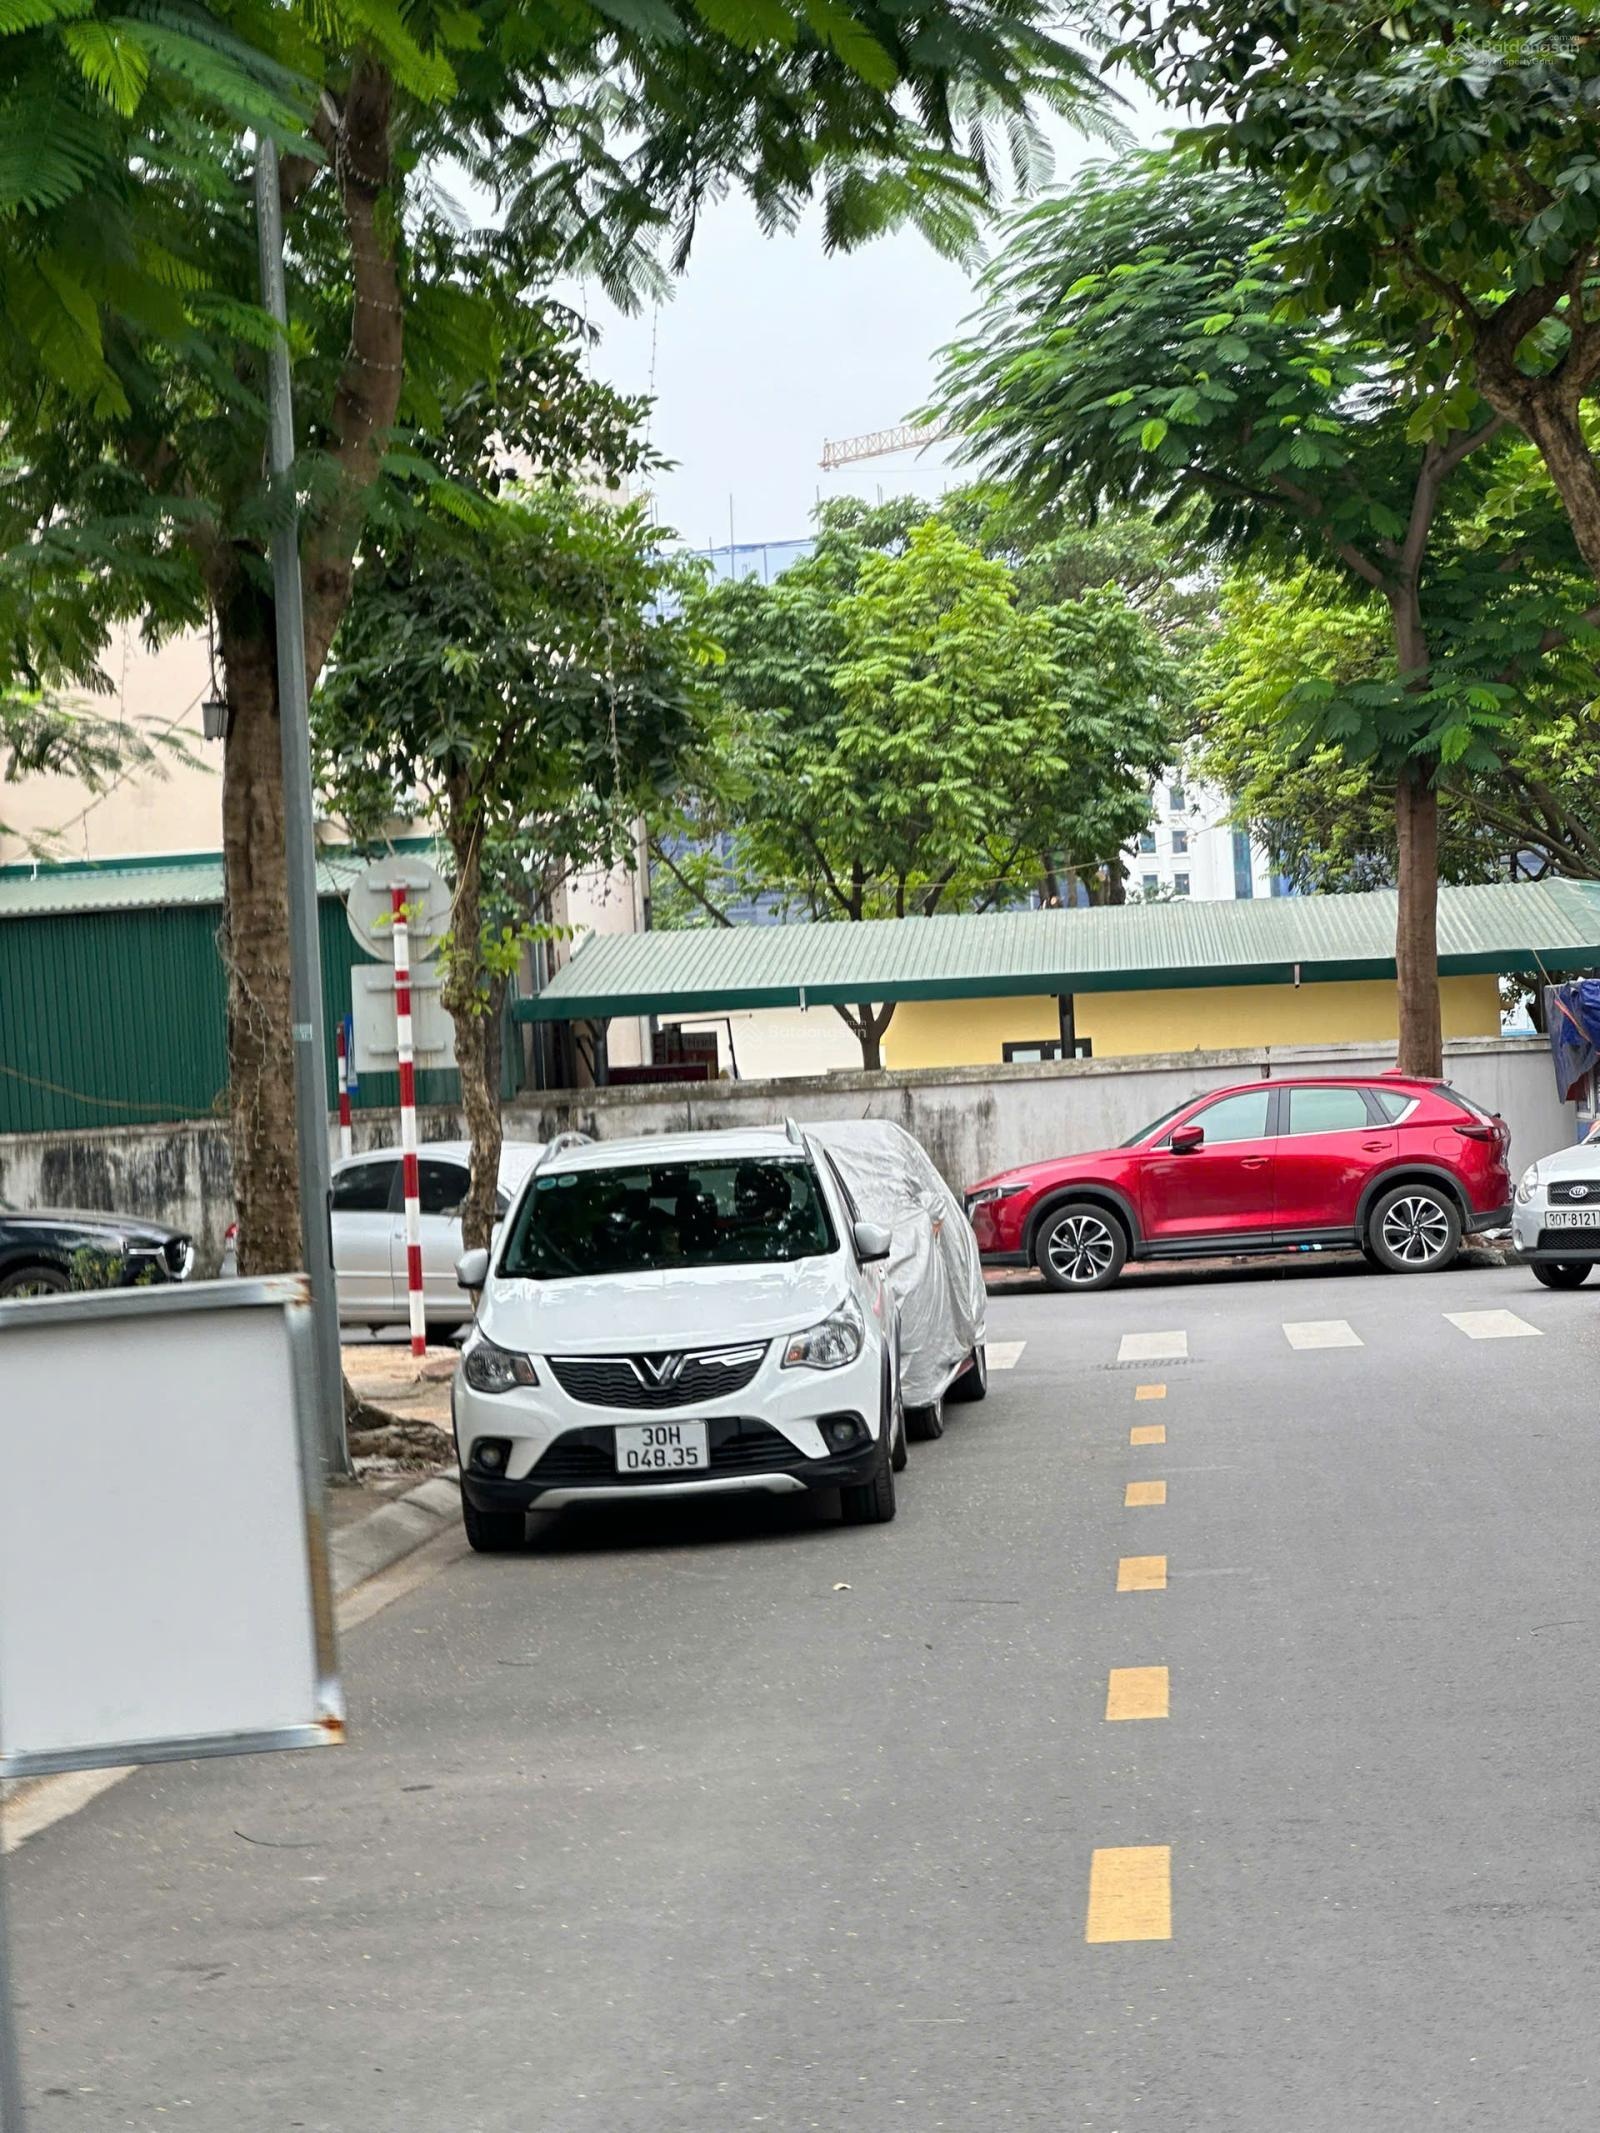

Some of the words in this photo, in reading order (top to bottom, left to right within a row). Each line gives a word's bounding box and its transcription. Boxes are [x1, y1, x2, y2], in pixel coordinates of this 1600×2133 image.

[1570, 1187, 1587, 1197] KIA
[641, 1425, 681, 1447] 30H
[626, 1447, 698, 1469] 048.35
